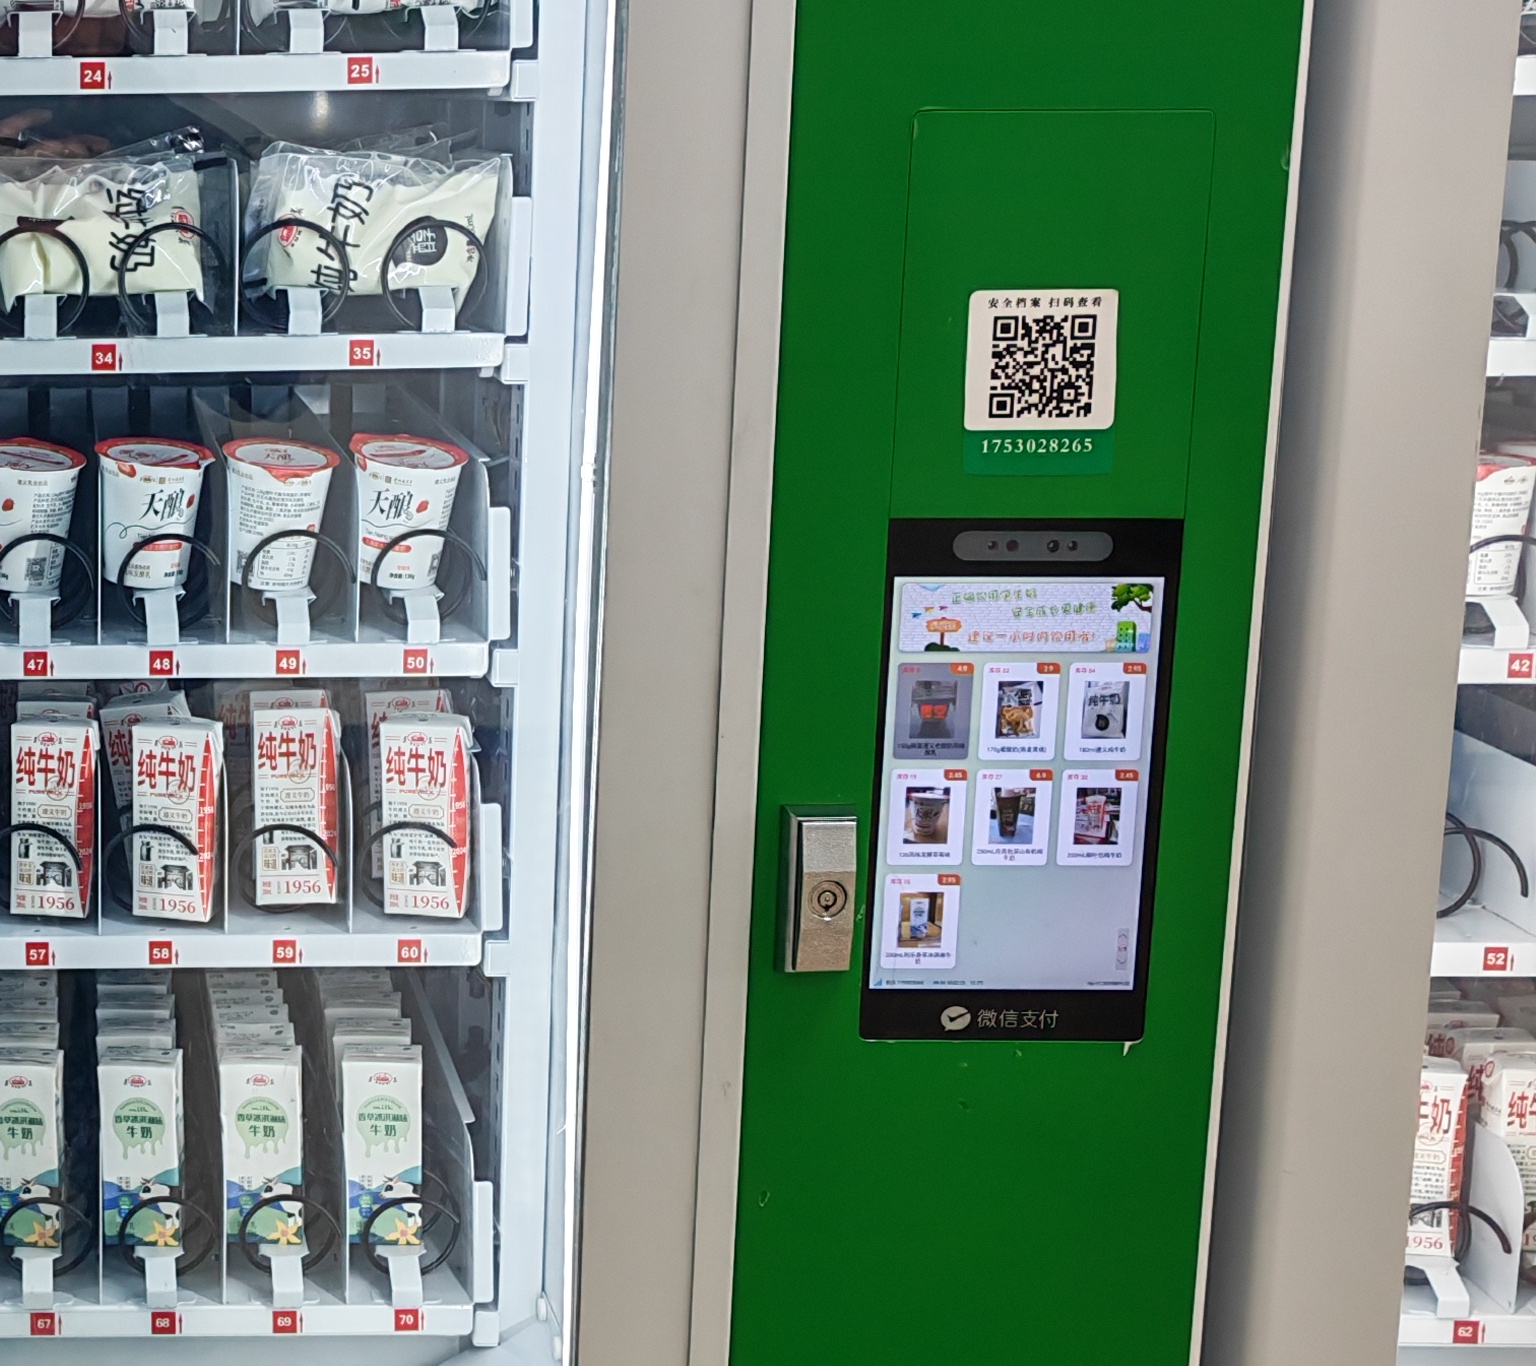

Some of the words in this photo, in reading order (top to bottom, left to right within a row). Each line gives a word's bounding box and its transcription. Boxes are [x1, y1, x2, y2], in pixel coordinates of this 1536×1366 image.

[83, 69, 102, 83] 24
[350, 64, 370, 78] 25
[987, 297, 1042, 309] 安全档案
[1048, 296, 1103, 309] 扫码查看
[95, 351, 113, 365] 34
[353, 347, 372, 360] 35
[980, 438, 1093, 453] 1753028265
[27, 658, 45, 671] 47
[152, 658, 171, 670] 48
[279, 657, 297, 670] 49
[406, 656, 425, 669] 50
[1510, 659, 1531, 672] 42
[257, 730, 316, 771] 纯牛奶
[16, 746, 76, 789] 纯牛奶
[137, 749, 196, 793] 纯牛奶
[385, 746, 447, 788] 纯牛奶
[284, 879, 321, 895] 1956
[37, 895, 75, 910] 1956
[160, 898, 197, 914] 1956
[412, 895, 450, 910] 1956
[29, 948, 47, 961] 57
[152, 947, 170, 959] 58
[276, 946, 294, 959] 59
[401, 946, 419, 959] 60
[1486, 952, 1506, 965] 52
[976, 1008, 1059, 1029] 微信支付
[7, 1127, 34, 1140] 牛奶
[126, 1126, 153, 1140] 牛奶
[248, 1124, 276, 1138] 牛奶
[369, 1124, 397, 1138] 牛奶
[37, 1318, 51, 1329] 67
[155, 1317, 170, 1328] 68
[277, 1316, 292, 1327] 69
[399, 1314, 414, 1325] 70
[1457, 1326, 1474, 1337] 62
